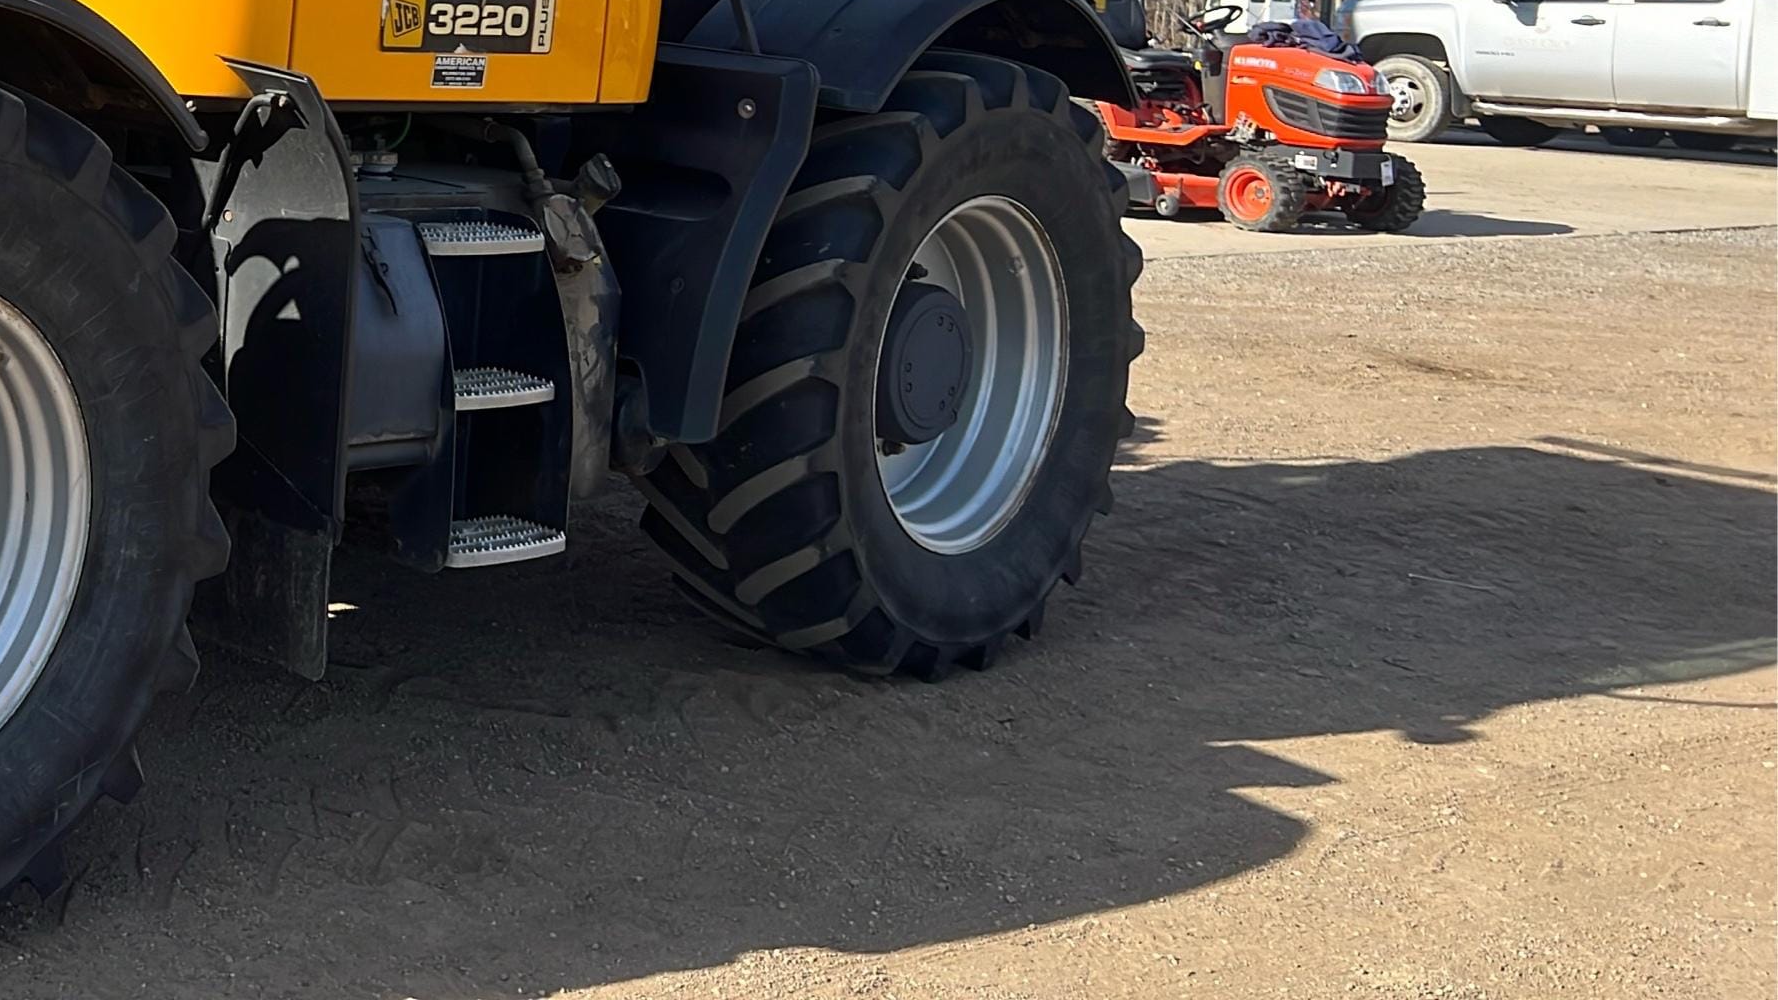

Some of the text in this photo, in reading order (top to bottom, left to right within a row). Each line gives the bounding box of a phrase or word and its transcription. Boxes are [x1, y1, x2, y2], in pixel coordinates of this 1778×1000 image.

[394, 2, 420, 33] JCB
[428, 3, 529, 36] 3220
[435, 57, 486, 66] AMERICAN
